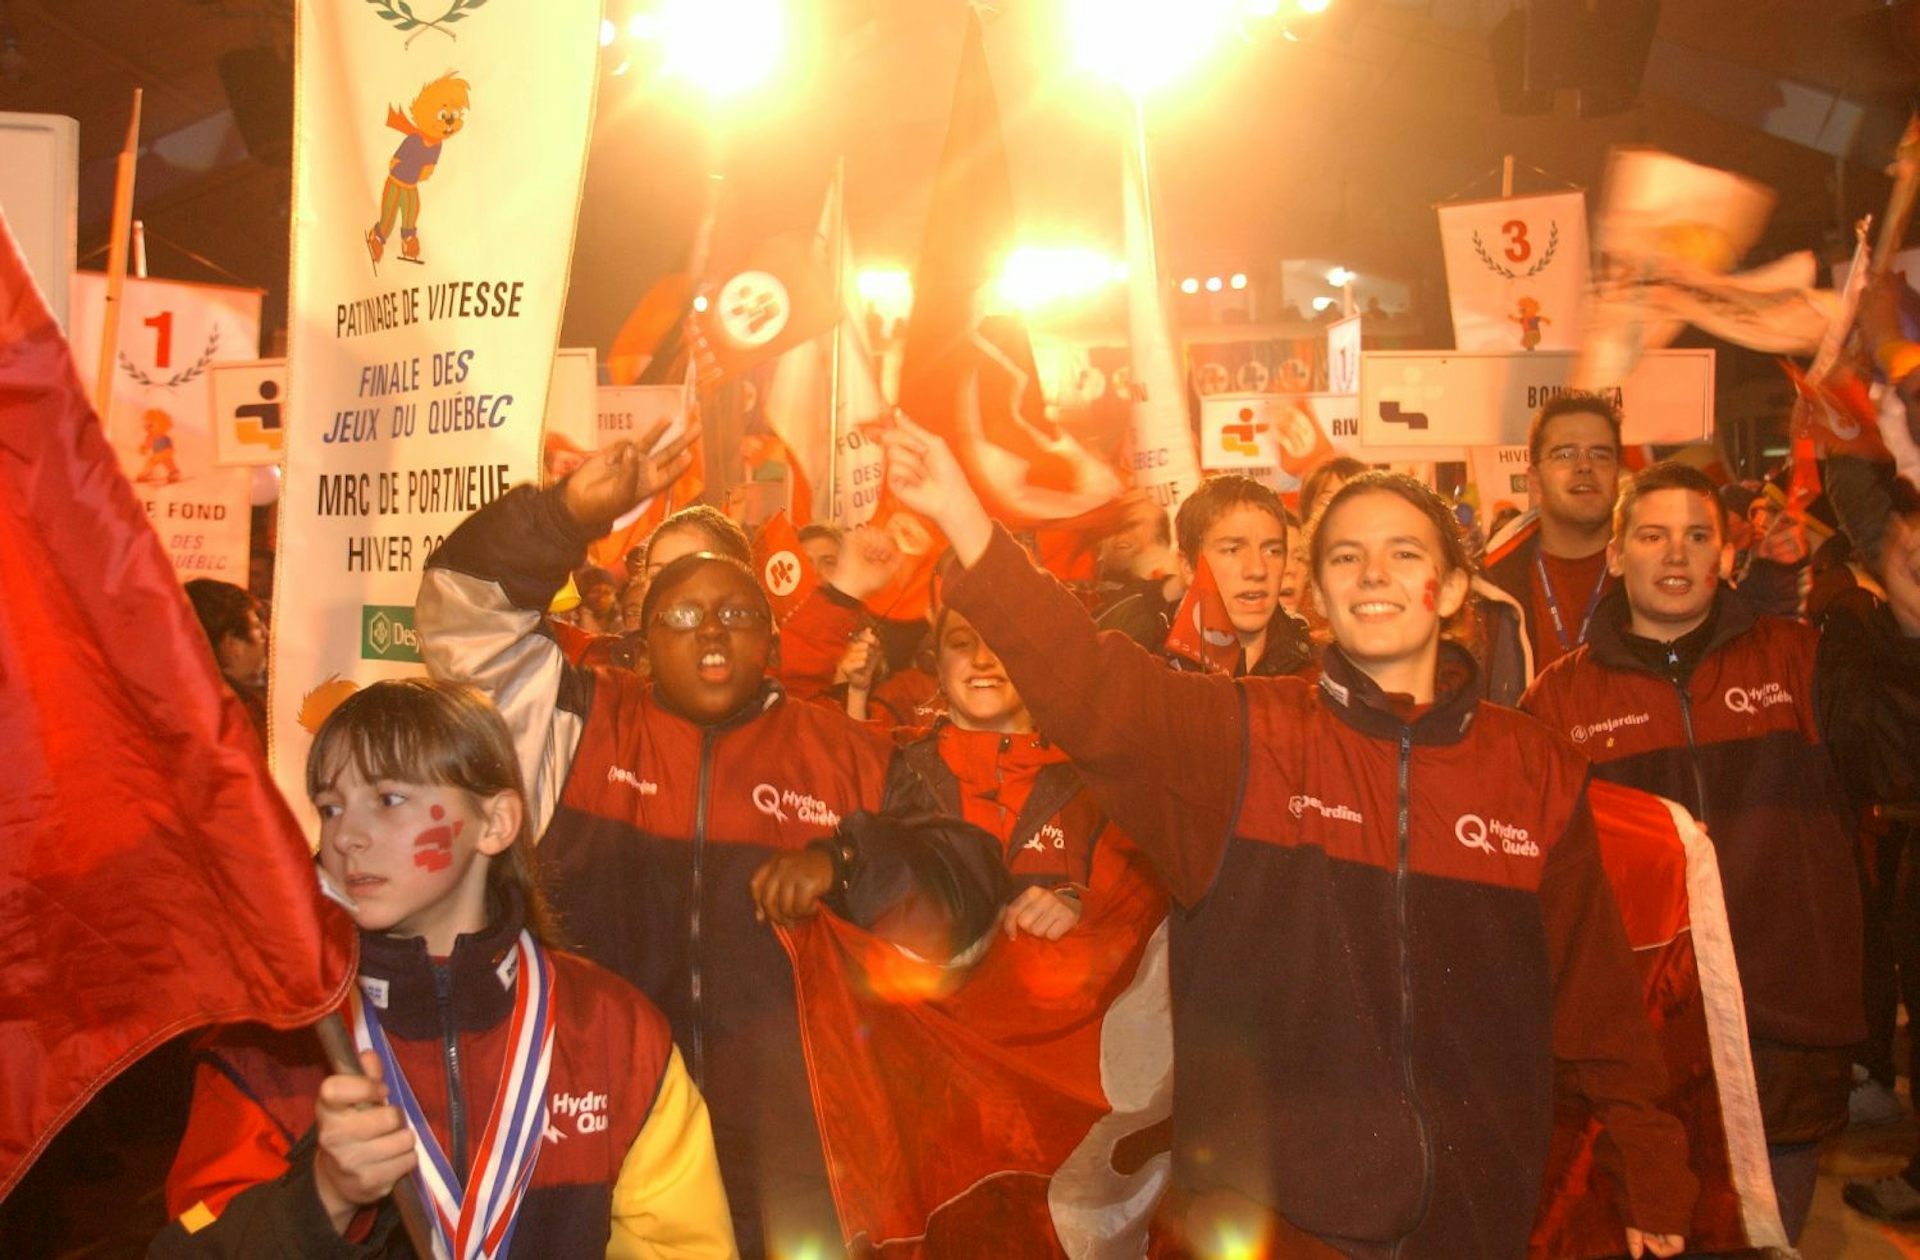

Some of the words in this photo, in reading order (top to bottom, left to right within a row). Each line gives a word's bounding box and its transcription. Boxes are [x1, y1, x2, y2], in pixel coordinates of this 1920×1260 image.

[1502, 220, 1531, 263] 3
[337, 292, 399, 338] PATINAGE
[402, 288, 420, 326] DE
[428, 281, 524, 321] VITESSE
[144, 311, 172, 368] 1
[359, 358, 420, 398] FINALE
[432, 349, 475, 388] DES
[322, 408, 380, 444] JEUX
[391, 403, 416, 439] DU
[428, 391, 514, 435] QUÉBEC
[1332, 418, 1359, 436] RIV
[167, 502, 226, 520] FOND
[318, 474, 370, 516] MRC
[379, 472, 399, 515] DE
[407, 464, 510, 513] PORTNEUF
[170, 534, 205, 549] DES
[348, 535, 412, 572] HIVER
[1489, 818, 1529, 841] Hydro
